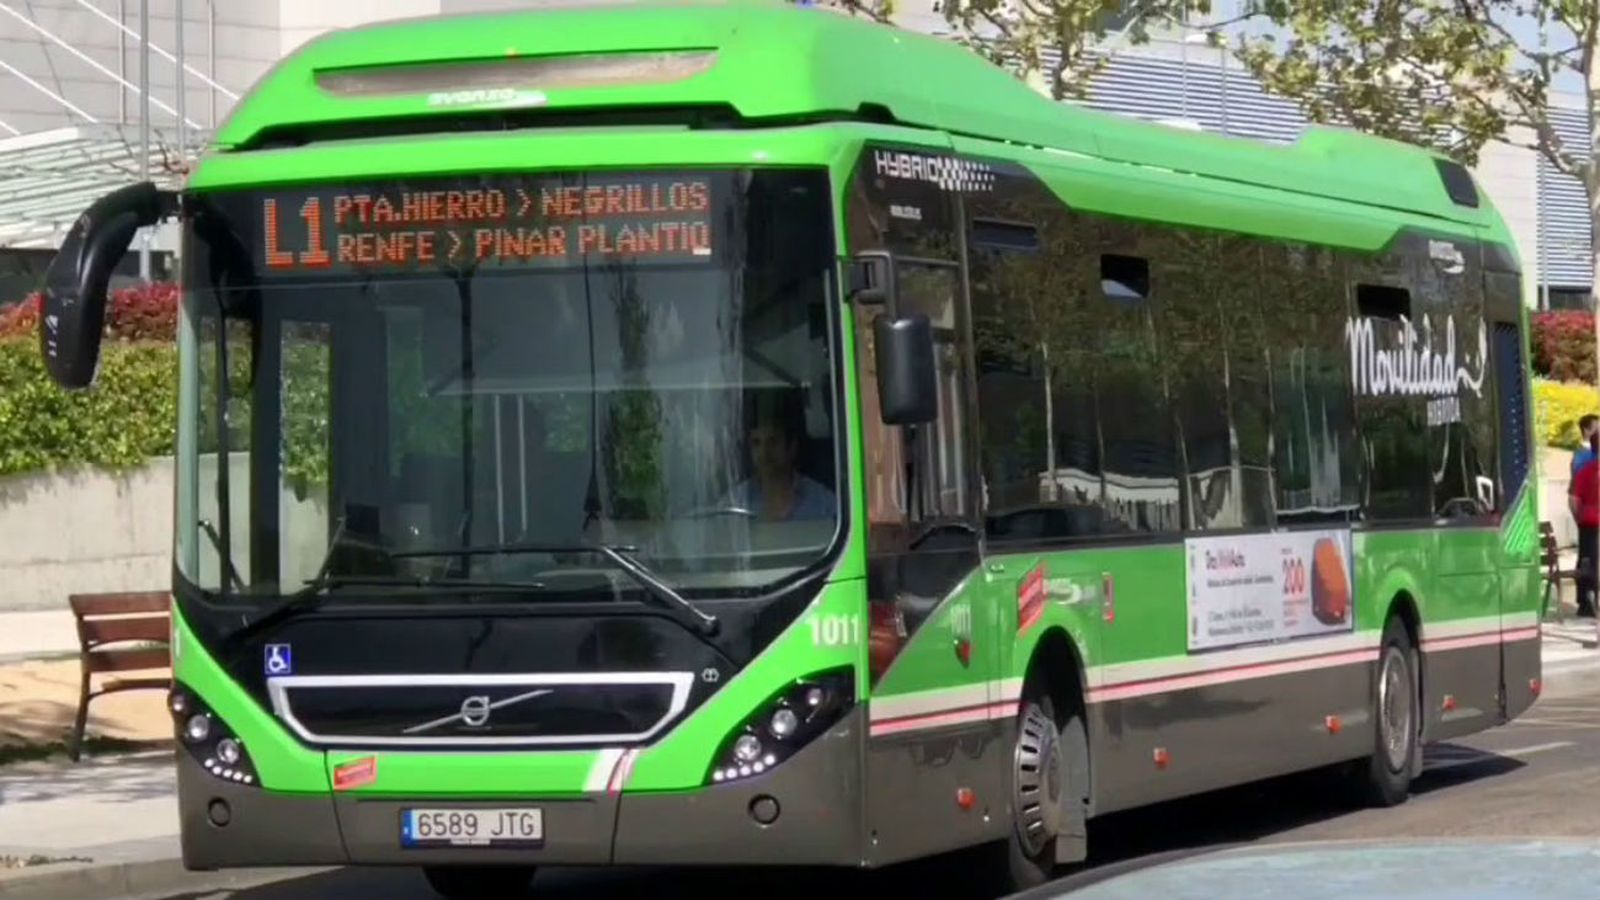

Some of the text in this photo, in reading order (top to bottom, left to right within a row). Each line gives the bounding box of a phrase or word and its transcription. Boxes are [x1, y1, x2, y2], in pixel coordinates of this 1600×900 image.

[874, 150, 939, 182] HYBRID
[334, 189, 505, 223] PTA.HIERRO
[541, 182, 708, 216] NEGRILLOS
[263, 196, 331, 266] L1
[337, 231, 435, 262] RENFE
[475, 225, 566, 257] PINAR
[1346, 312, 1462, 397] Movilidad
[1282, 557, 1305, 594] 200
[807, 614, 859, 646] 1011
[418, 811, 534, 837] 6589 JTG
